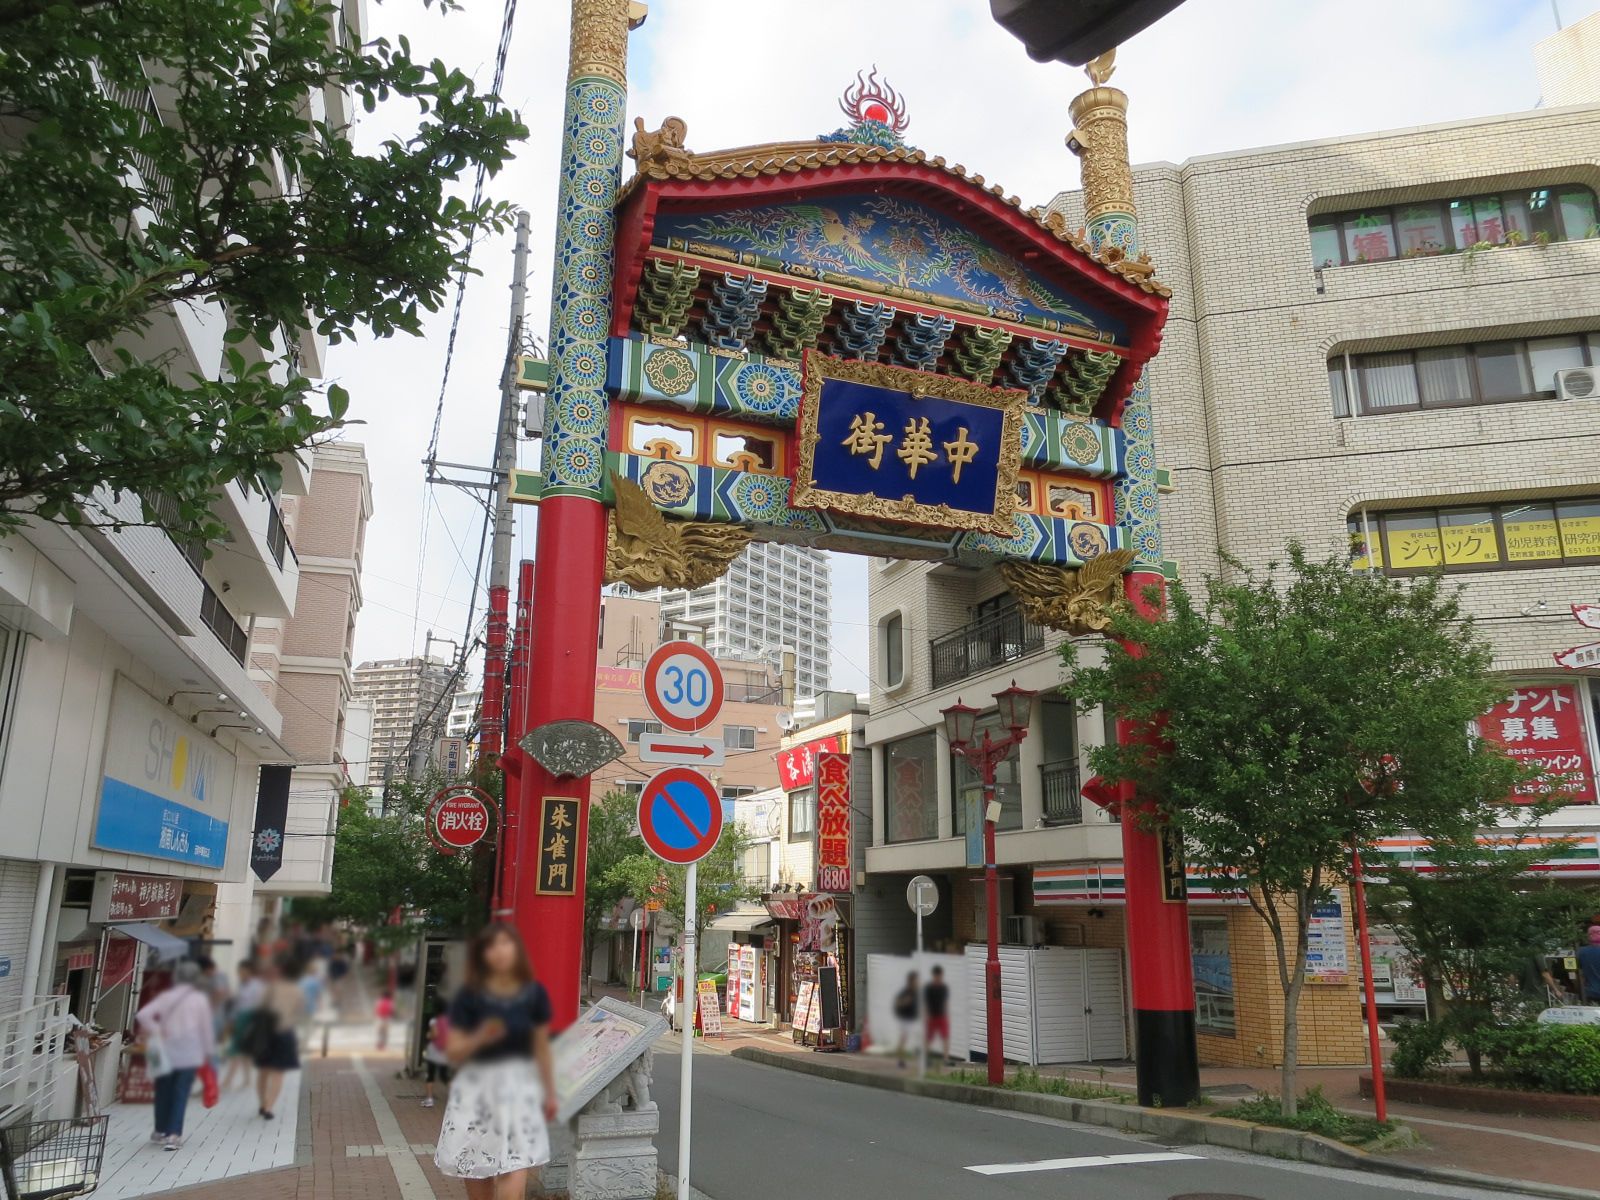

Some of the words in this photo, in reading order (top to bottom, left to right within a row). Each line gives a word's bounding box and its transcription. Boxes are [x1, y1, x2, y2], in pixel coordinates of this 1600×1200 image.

[1401, 535, 1482, 560] ジャック
[663, 665, 707, 707] 30
[1484, 689, 1571, 715] ナント
[1500, 716, 1559, 741] 募集
[440, 811, 484, 831] 消火栓
[819, 754, 850, 868] 食べ放題
[543, 803, 573, 889] 朱雀門
